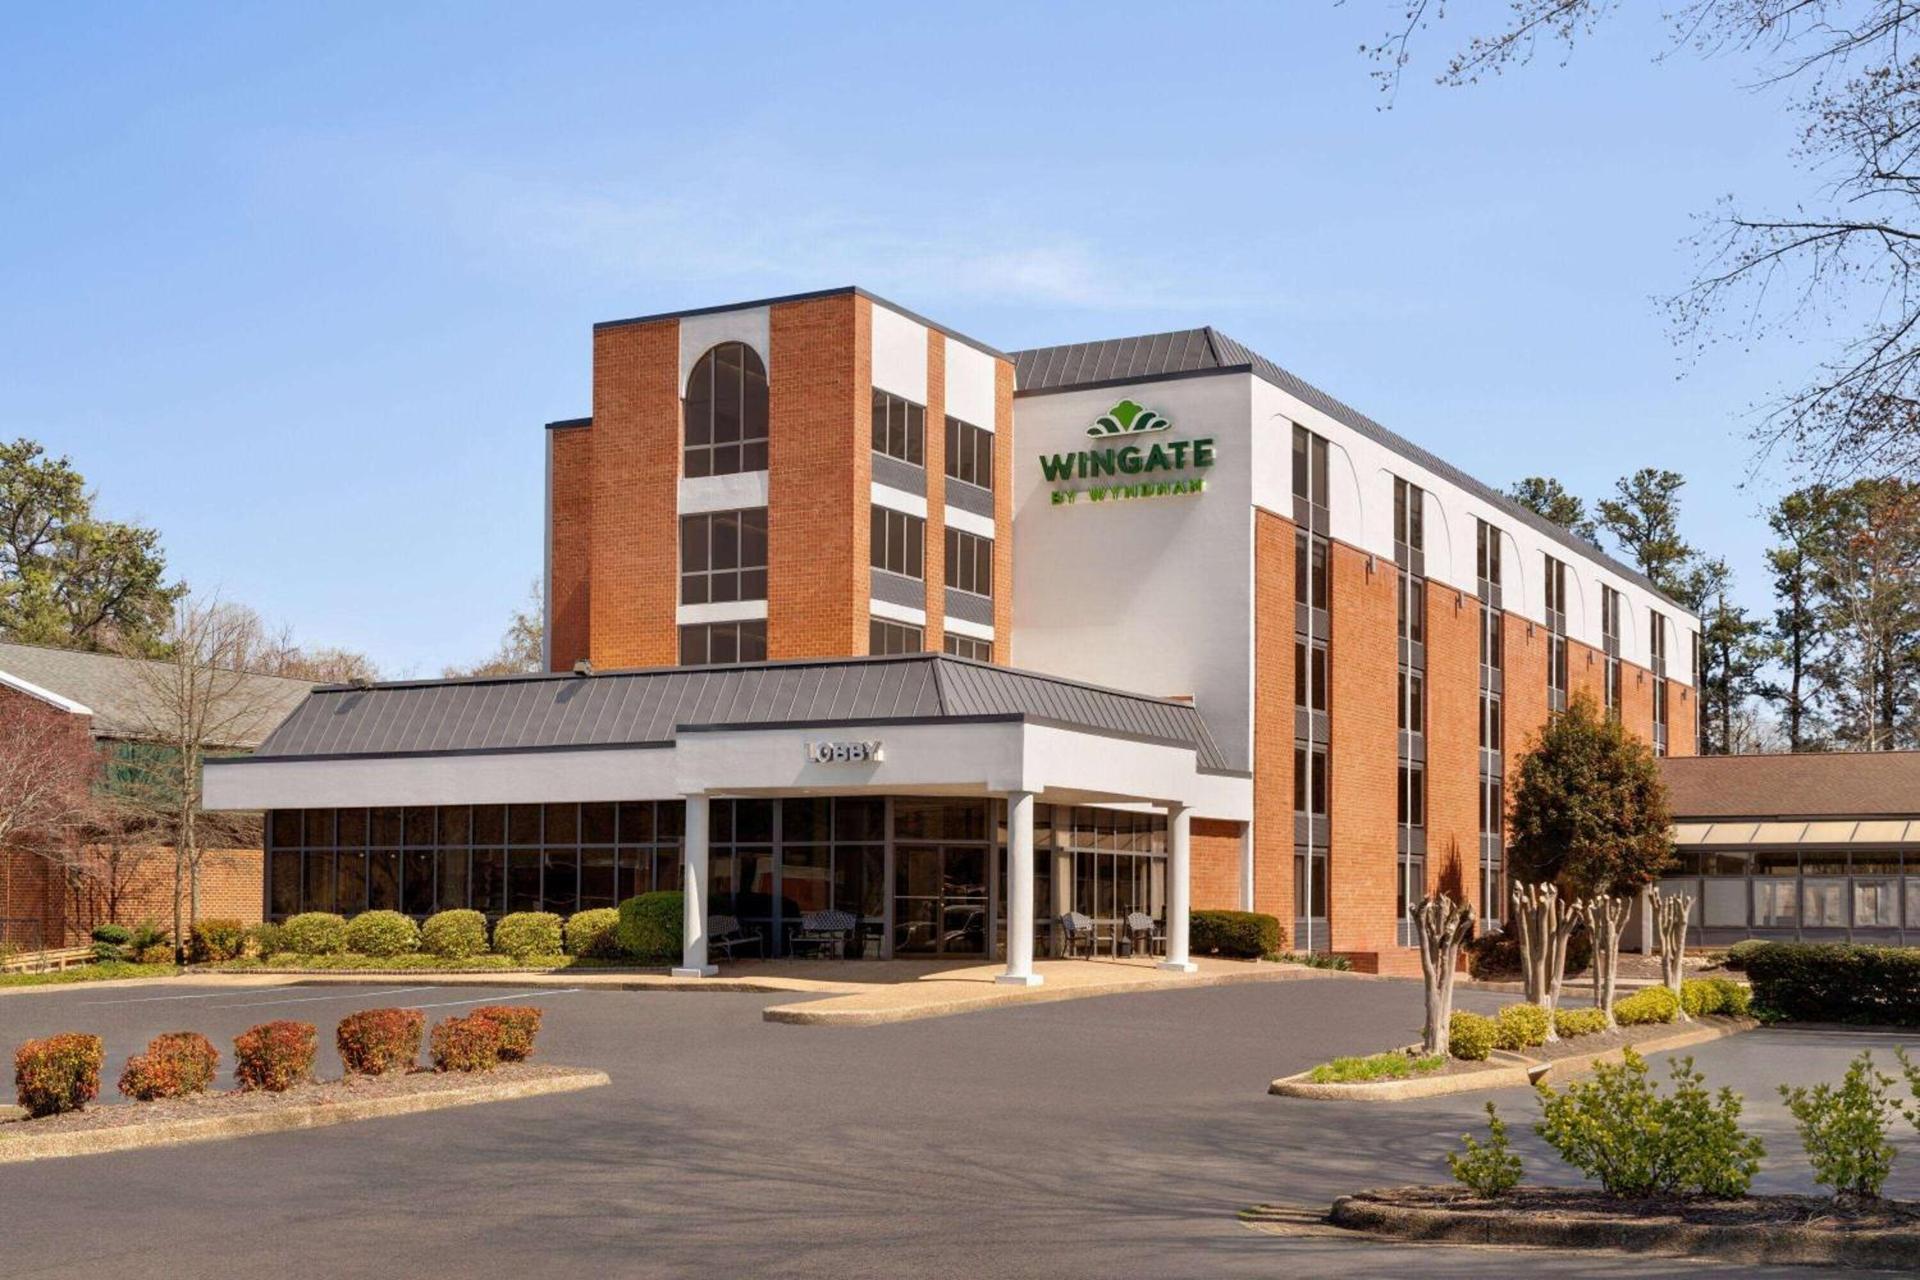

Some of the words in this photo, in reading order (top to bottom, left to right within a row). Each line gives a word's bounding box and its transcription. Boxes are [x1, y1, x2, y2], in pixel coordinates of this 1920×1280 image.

[1039, 438, 1215, 482] WINGATE
[1051, 488, 1077, 505] BY
[1088, 479, 1205, 503] WYNDHAM
